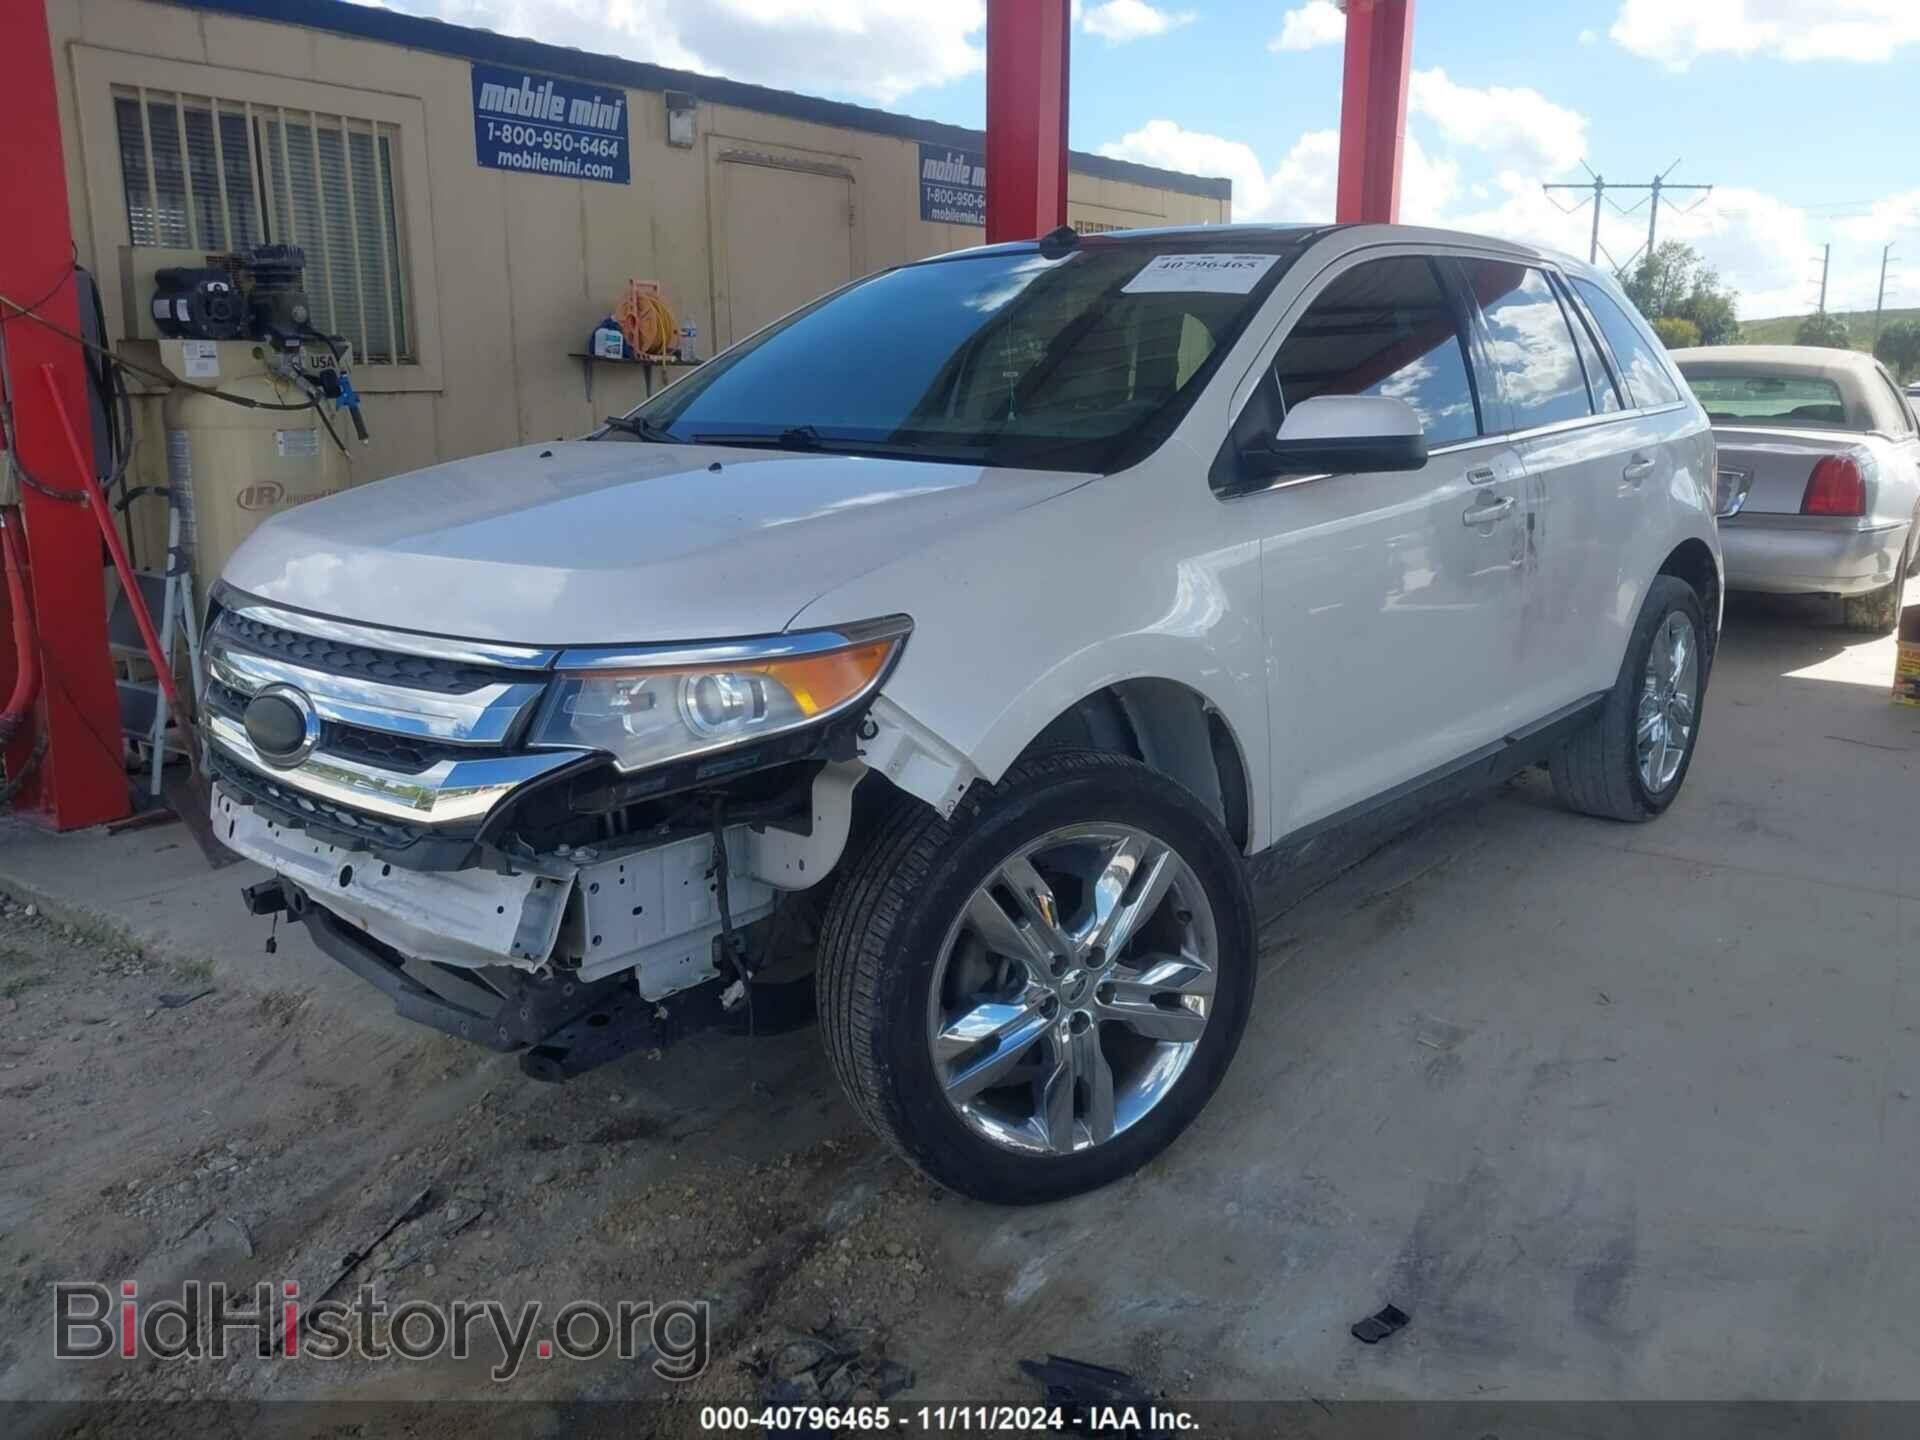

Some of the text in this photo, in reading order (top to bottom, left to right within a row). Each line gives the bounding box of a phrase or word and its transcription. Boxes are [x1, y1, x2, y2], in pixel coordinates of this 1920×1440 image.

[479, 76, 623, 131] mobile mini
[487, 122, 619, 158] 1-800-950-6464
[497, 151, 613, 179] mobilemini.com
[922, 152, 971, 184] mobile
[311, 356, 336, 369] USA
